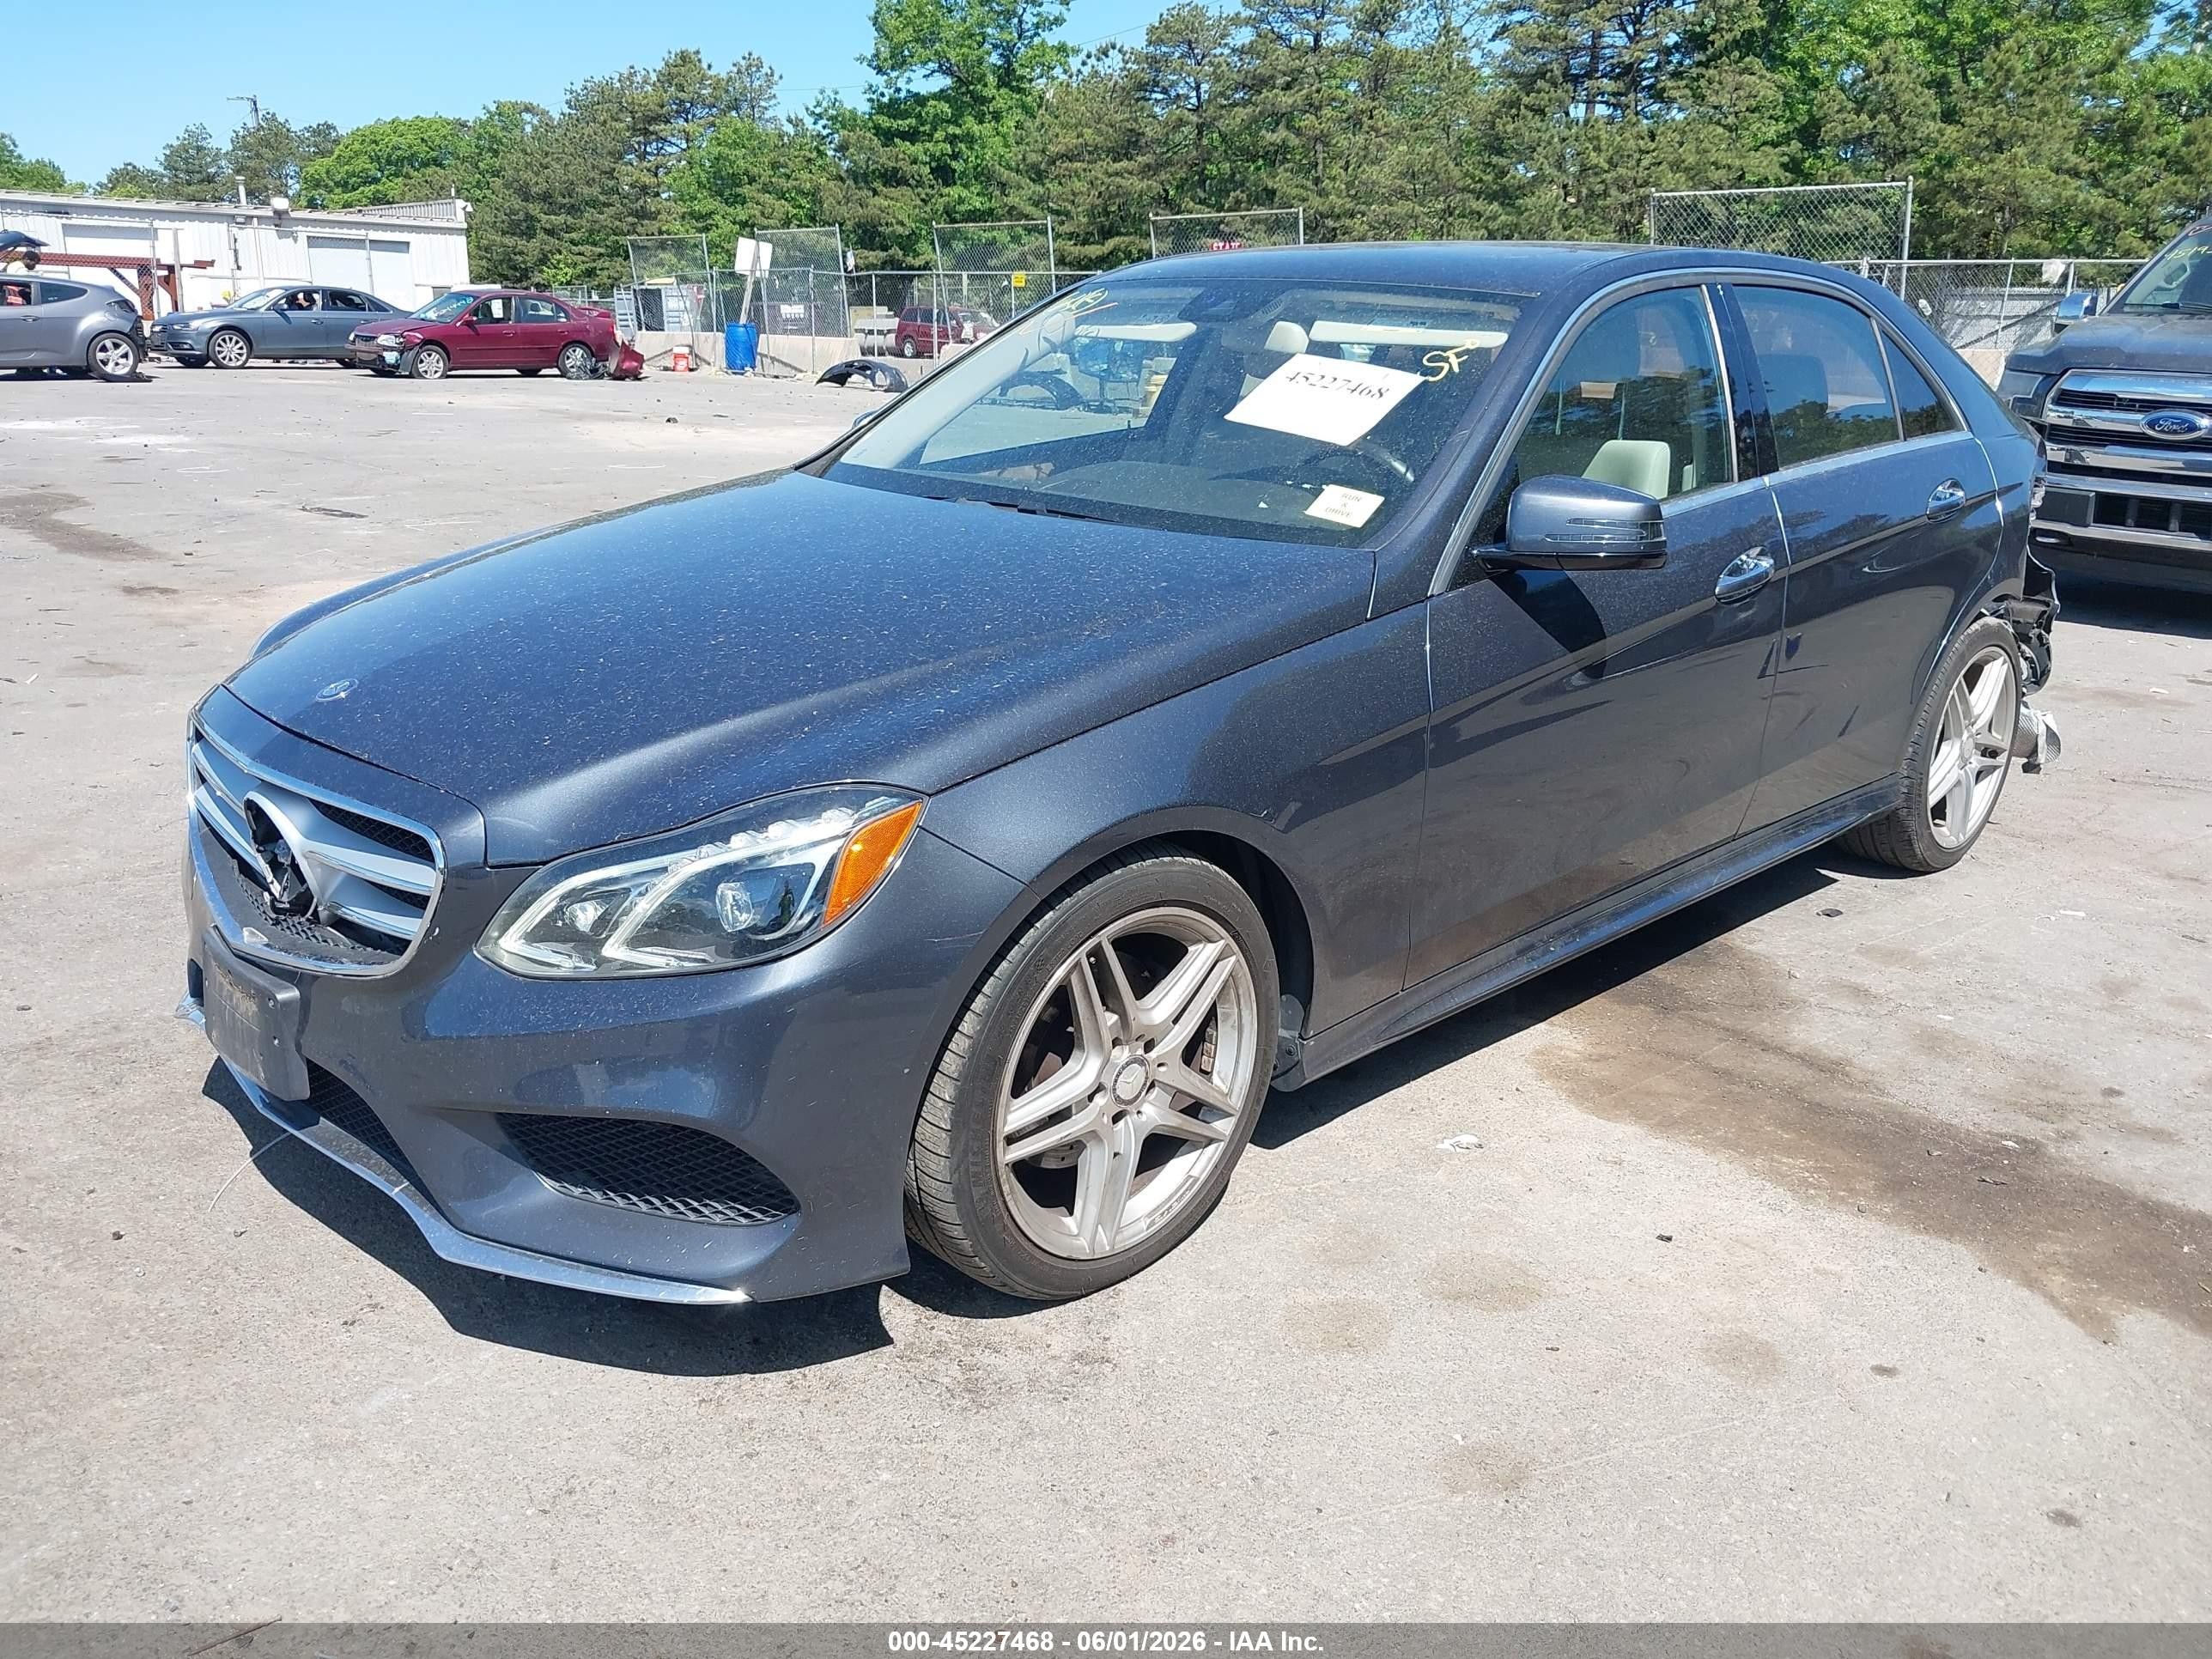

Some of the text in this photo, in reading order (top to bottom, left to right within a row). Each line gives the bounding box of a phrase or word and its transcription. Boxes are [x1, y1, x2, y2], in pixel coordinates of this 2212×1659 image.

[1285, 371, 1390, 399] 45227468
[2154, 417, 2190, 433] Ford
[1341, 494, 1363, 502] RUN
[1325, 507, 1353, 517] DRIVE
